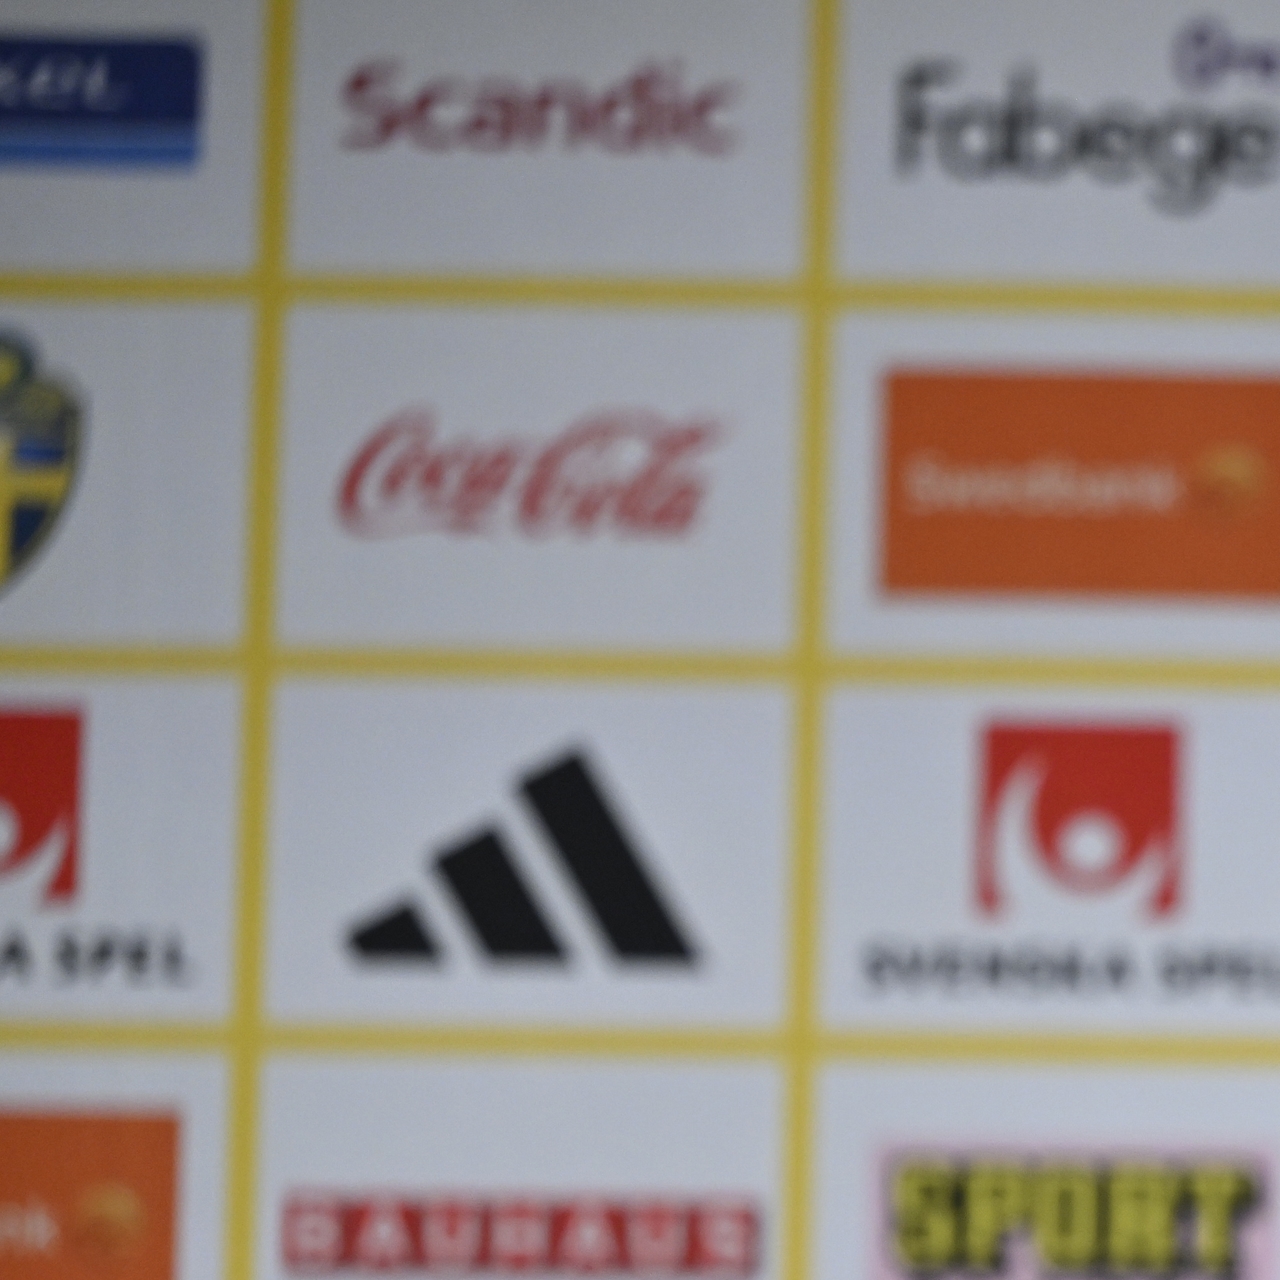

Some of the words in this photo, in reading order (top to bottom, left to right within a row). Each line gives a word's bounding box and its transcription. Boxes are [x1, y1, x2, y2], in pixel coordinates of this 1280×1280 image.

[338, 56, 742, 155] Scandic
[53, 932, 192, 988] SPEL
[294, 1195, 752, 1272] BAUHAUS
